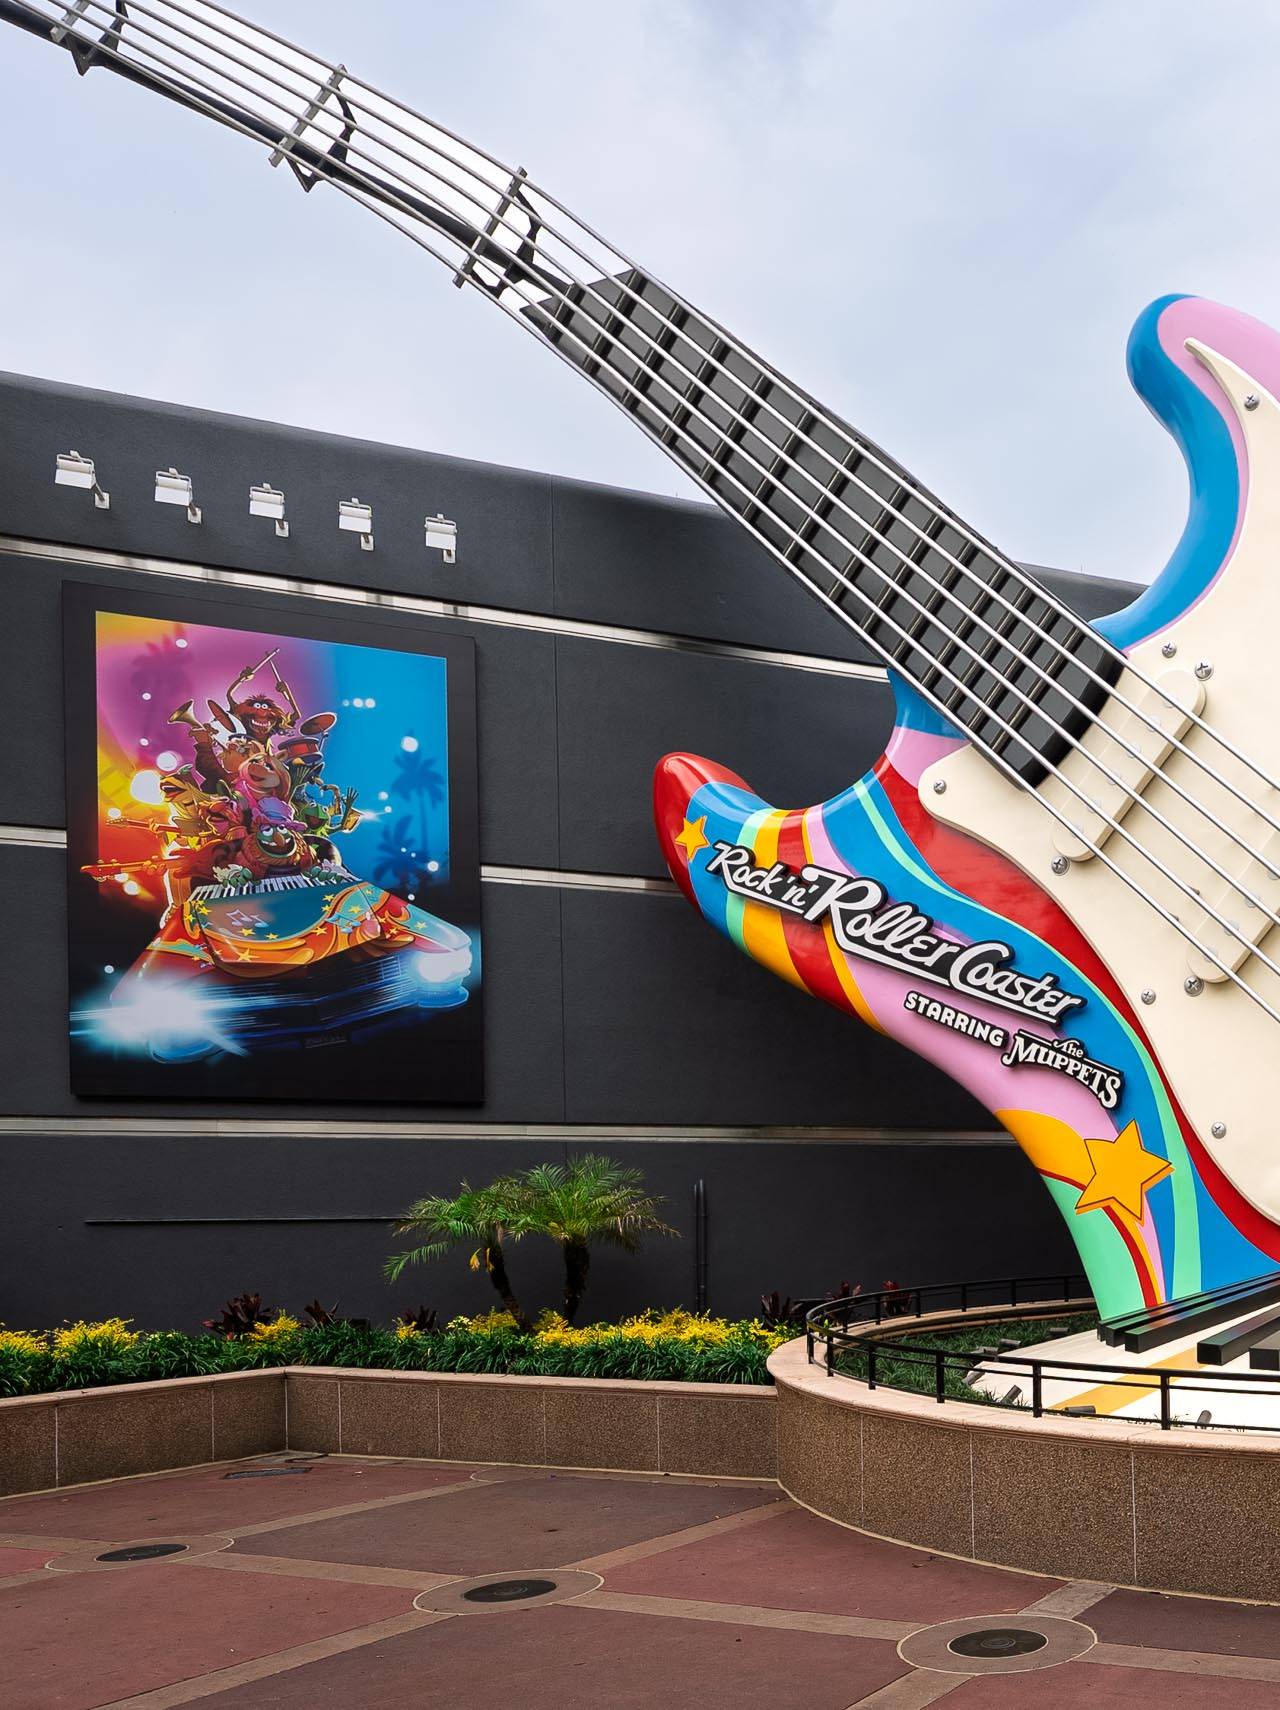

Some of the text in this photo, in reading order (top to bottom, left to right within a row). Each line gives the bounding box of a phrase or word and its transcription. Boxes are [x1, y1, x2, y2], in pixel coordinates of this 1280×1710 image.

[707, 843, 783, 908] Rock
[801, 866, 960, 985] Roller
[950, 942, 1082, 1024] Coaster
[906, 993, 1004, 1047] STARRING
[1052, 1040, 1084, 1058] The
[1001, 1035, 1121, 1109] MUPPETS
